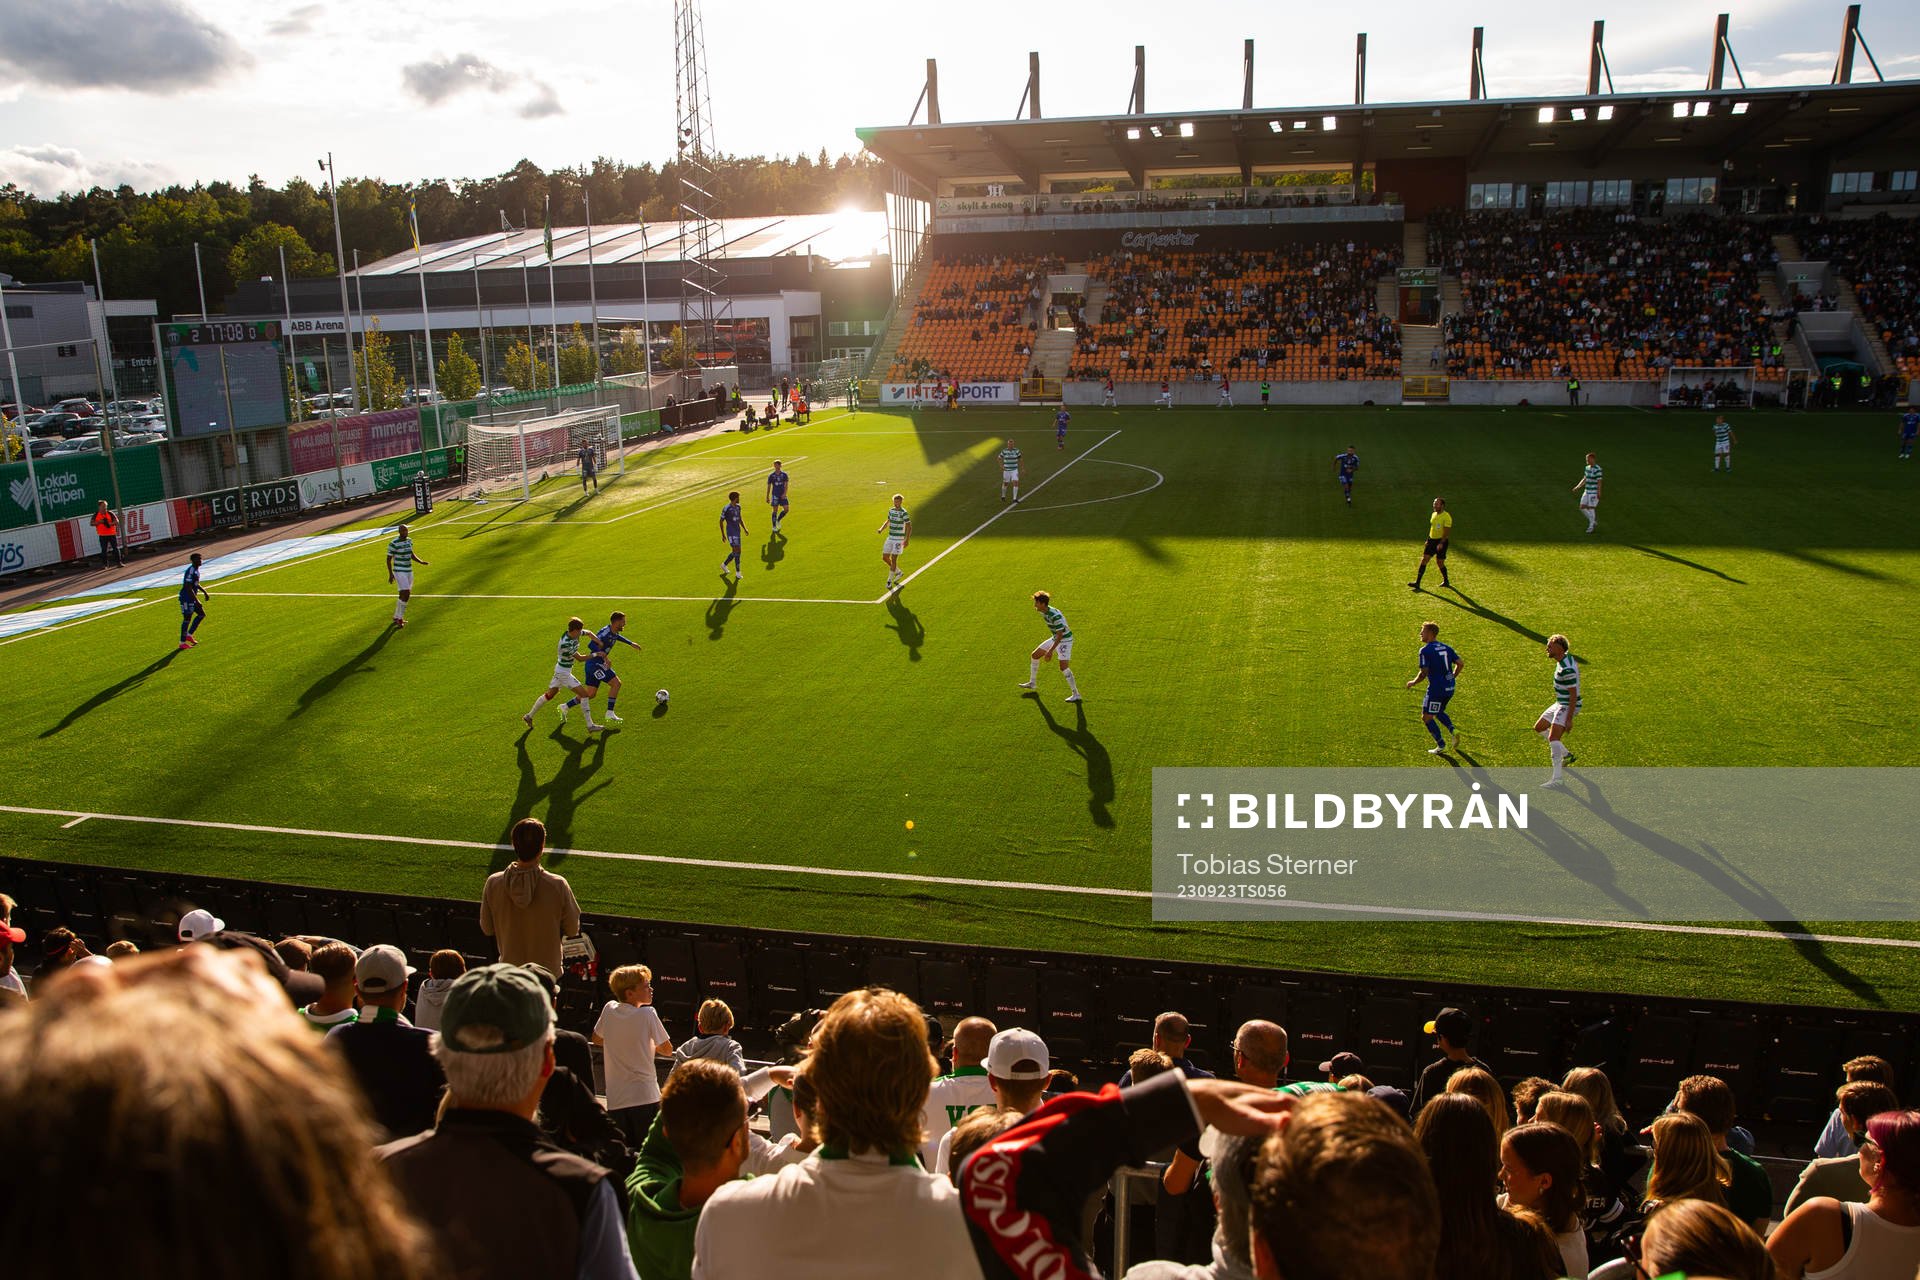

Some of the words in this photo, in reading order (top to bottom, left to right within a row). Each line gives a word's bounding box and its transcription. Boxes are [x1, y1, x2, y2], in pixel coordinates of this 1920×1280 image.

[1121, 229, 1200, 252] Carpenter
[192, 329, 200, 342] 2
[291, 320, 312, 332] ABB
[315, 319, 345, 331] Arena
[37, 472, 78, 490] Lokala
[39, 487, 85, 510] Hjälpen
[415, 482, 424, 511] SELECT
[1438, 651, 1449, 671] 7
